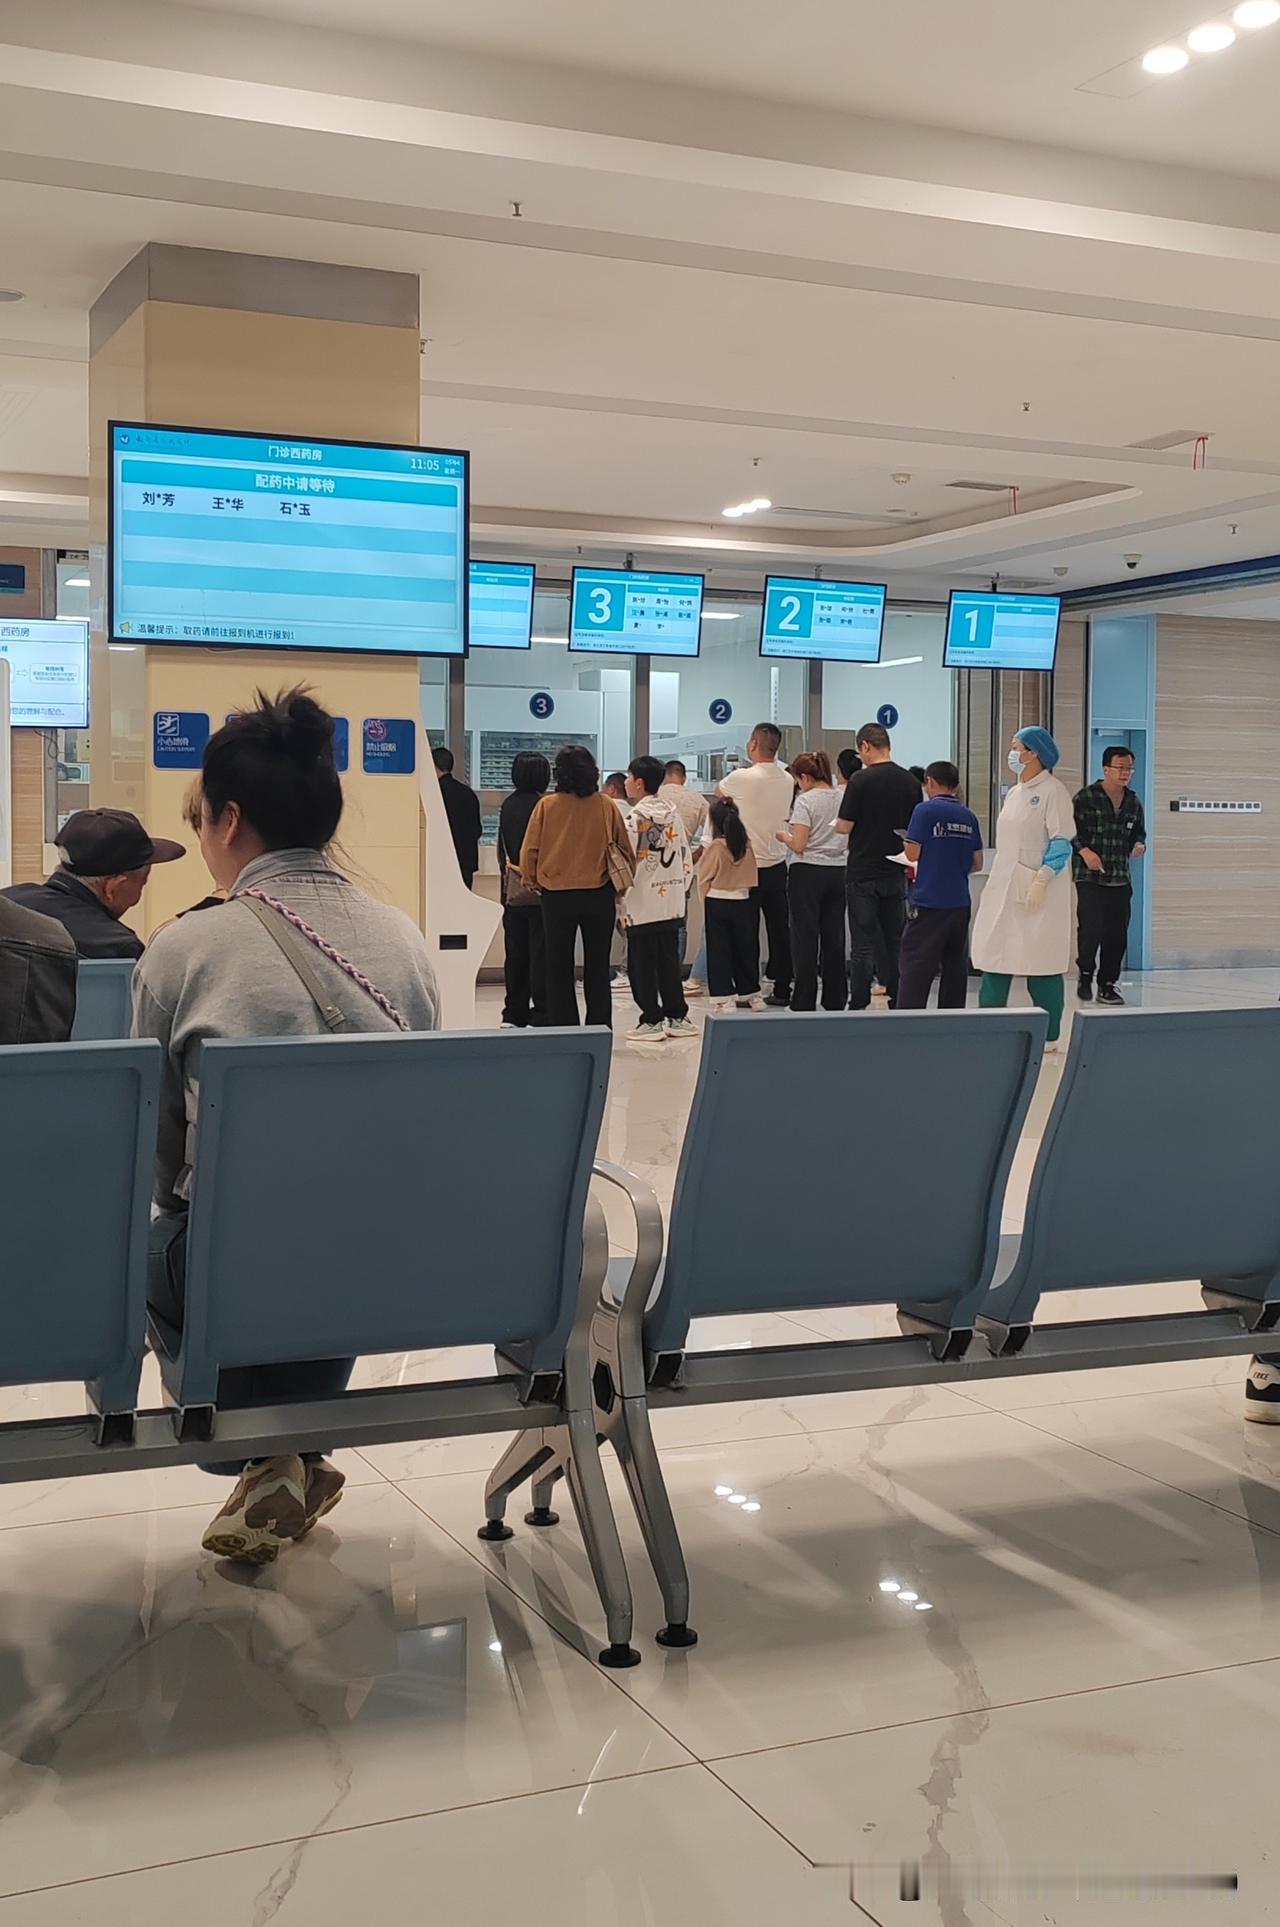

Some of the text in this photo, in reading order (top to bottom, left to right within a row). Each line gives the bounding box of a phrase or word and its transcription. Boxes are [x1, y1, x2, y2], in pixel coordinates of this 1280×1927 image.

[268, 445, 322, 461] 门诊西药房
[411, 458, 440, 471] 11:05
[255, 473, 335, 493] 配药中请等待
[587, 587, 612, 624] 3
[778, 595, 801, 631] 2
[964, 608, 979, 642] 1
[536, 698, 548, 713] 3
[715, 704, 726, 719] 2
[883, 709, 891, 724] 1
